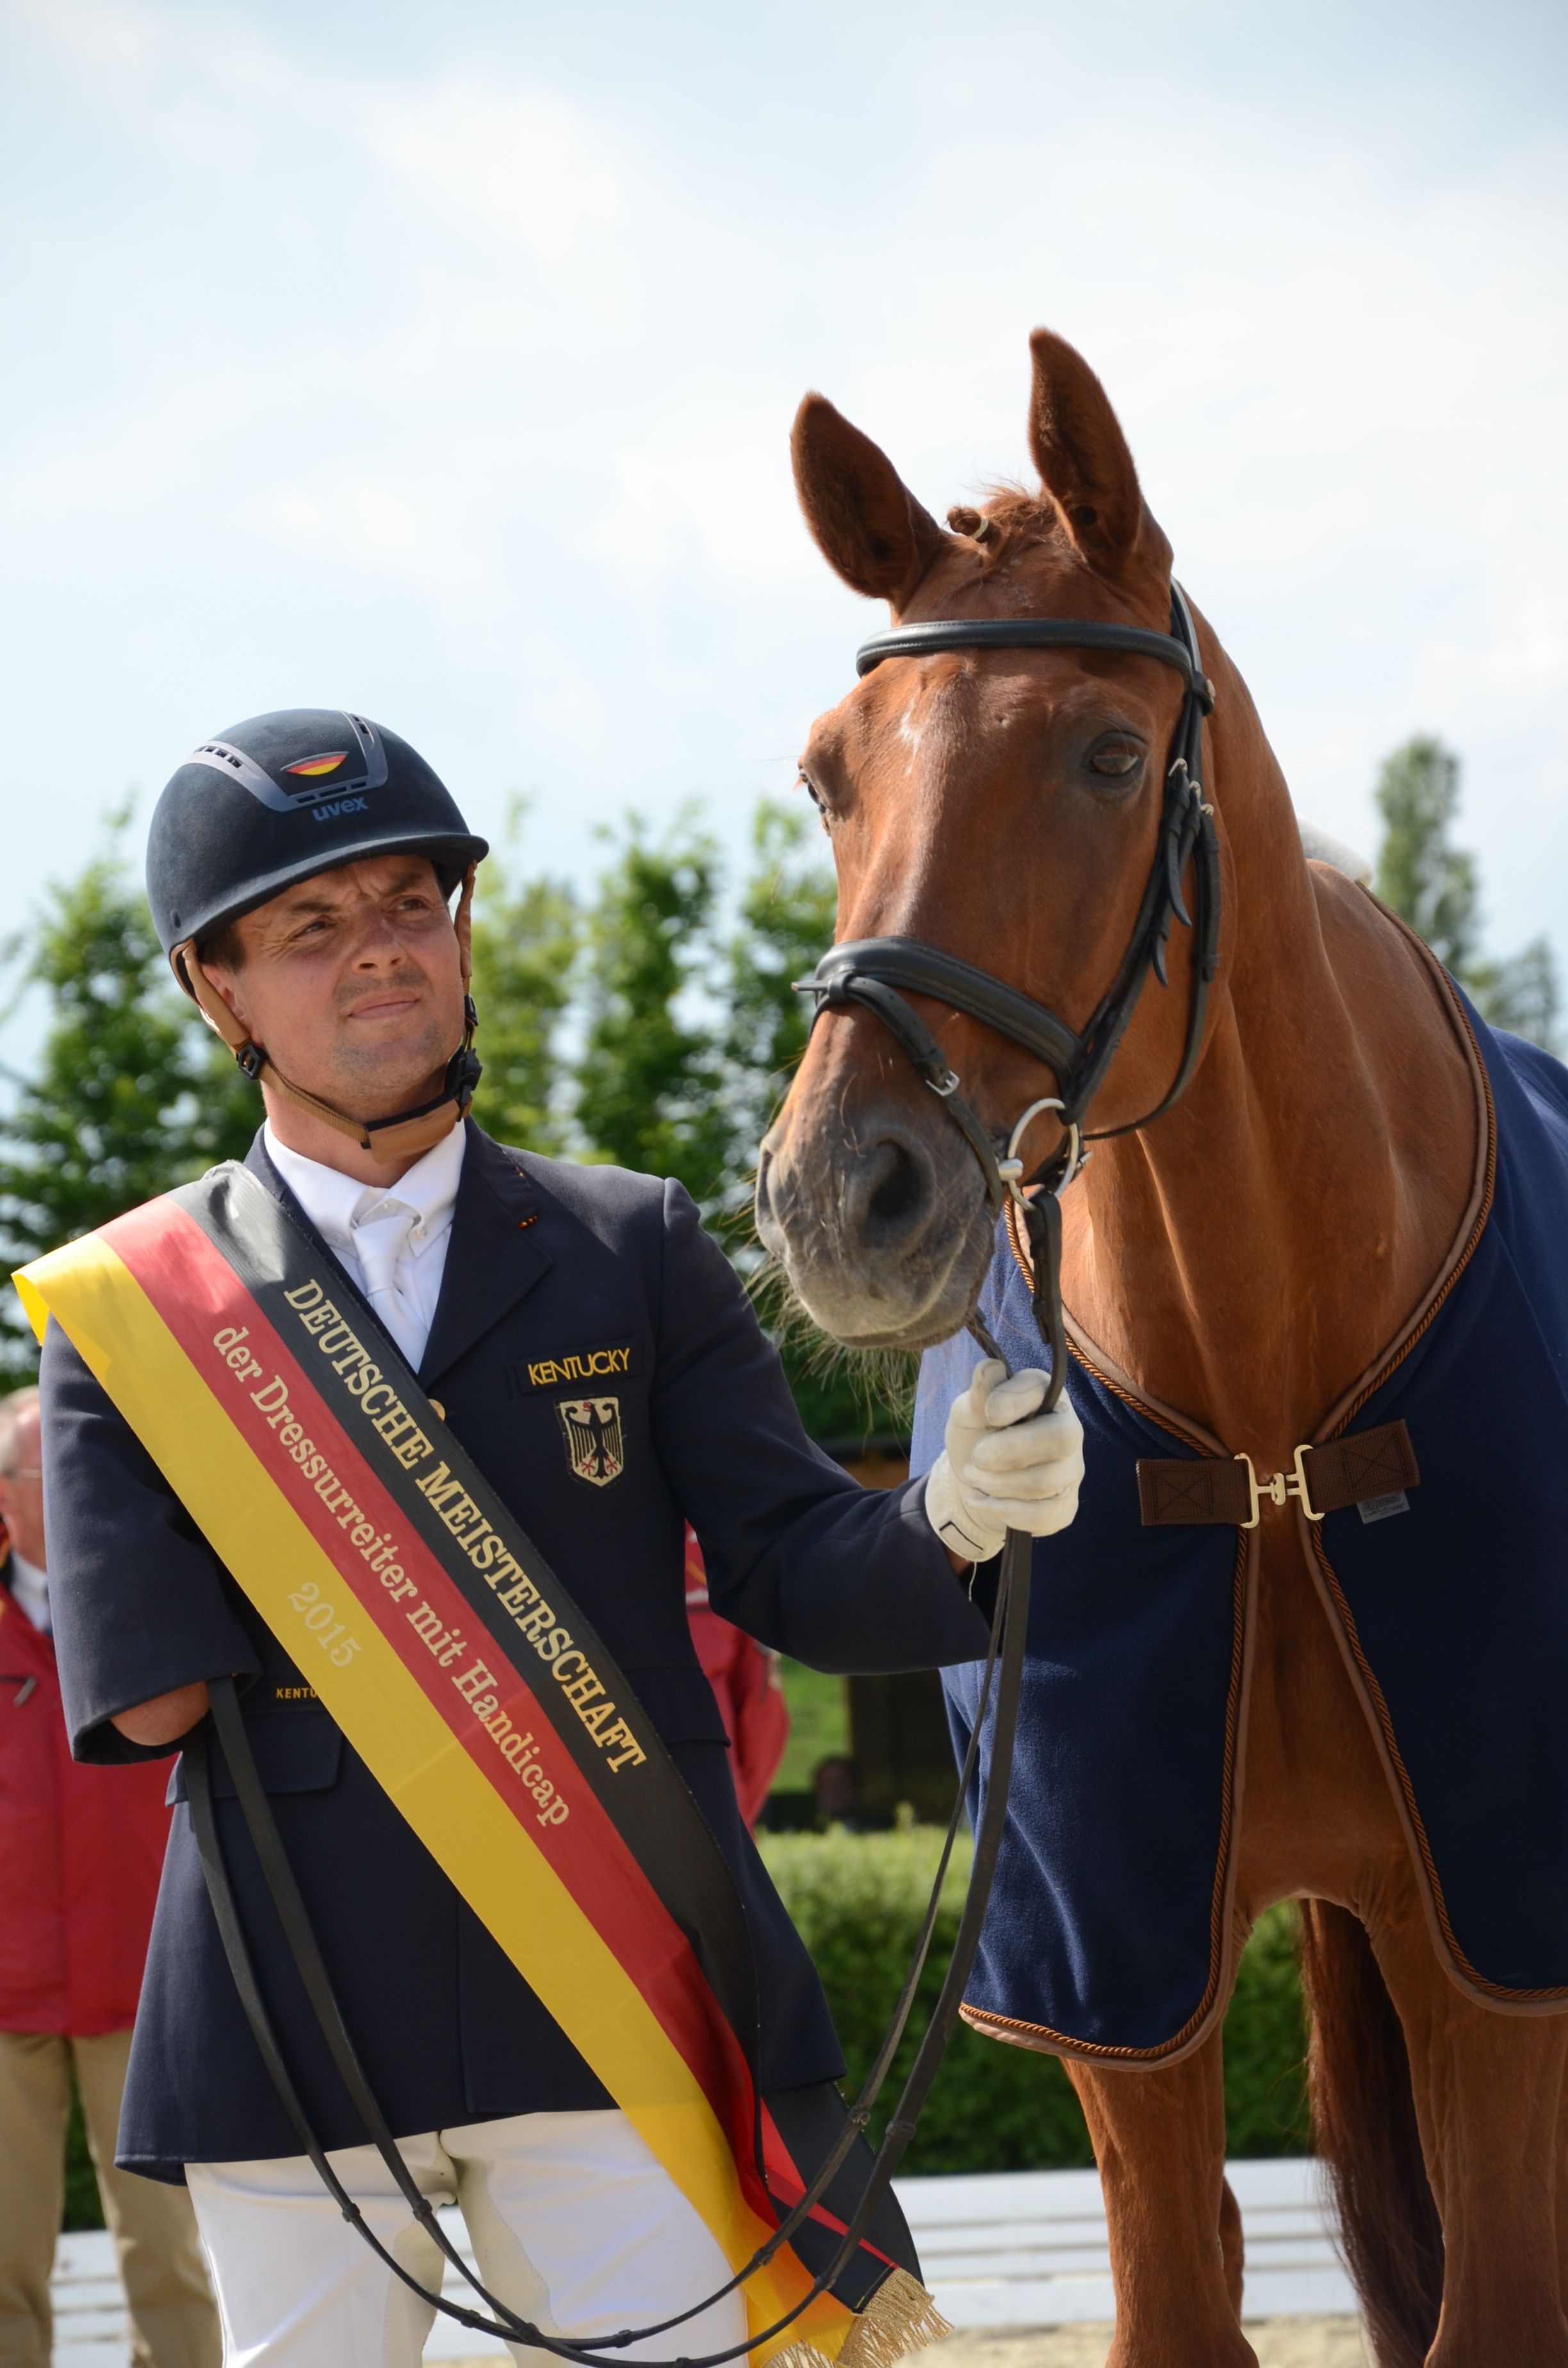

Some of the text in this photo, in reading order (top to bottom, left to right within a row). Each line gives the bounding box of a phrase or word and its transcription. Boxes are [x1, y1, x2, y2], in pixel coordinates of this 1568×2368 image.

[312, 797, 369, 821] uvex
[528, 1348, 630, 1385] KENTUCKY
[284, 1279, 646, 1772] DEUTSCHE MEISTERSCHAFT
[213, 1326, 569, 1827] der Dressurreiter mit Handicap
[288, 1581, 363, 1666] 2015
